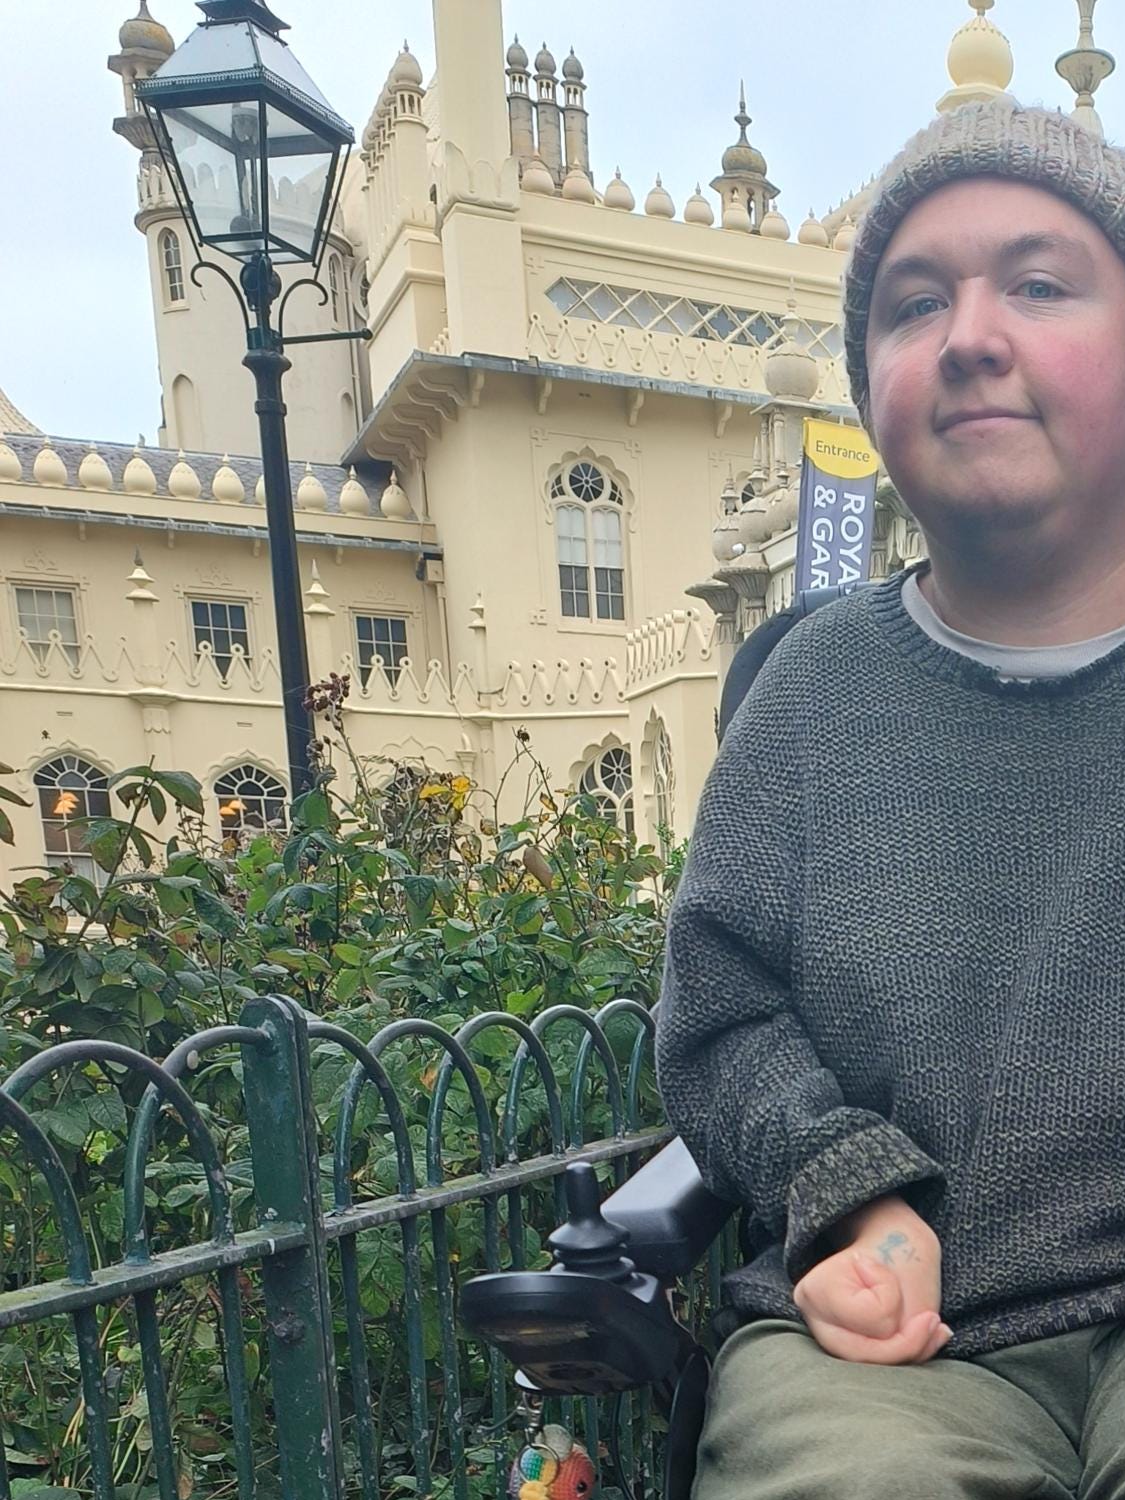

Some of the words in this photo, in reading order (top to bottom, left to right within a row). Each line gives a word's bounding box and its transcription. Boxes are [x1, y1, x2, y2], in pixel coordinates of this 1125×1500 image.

[815, 439, 871, 463] Entrance
[813, 484, 837, 509] &
[837, 492, 866, 595] ROYA
